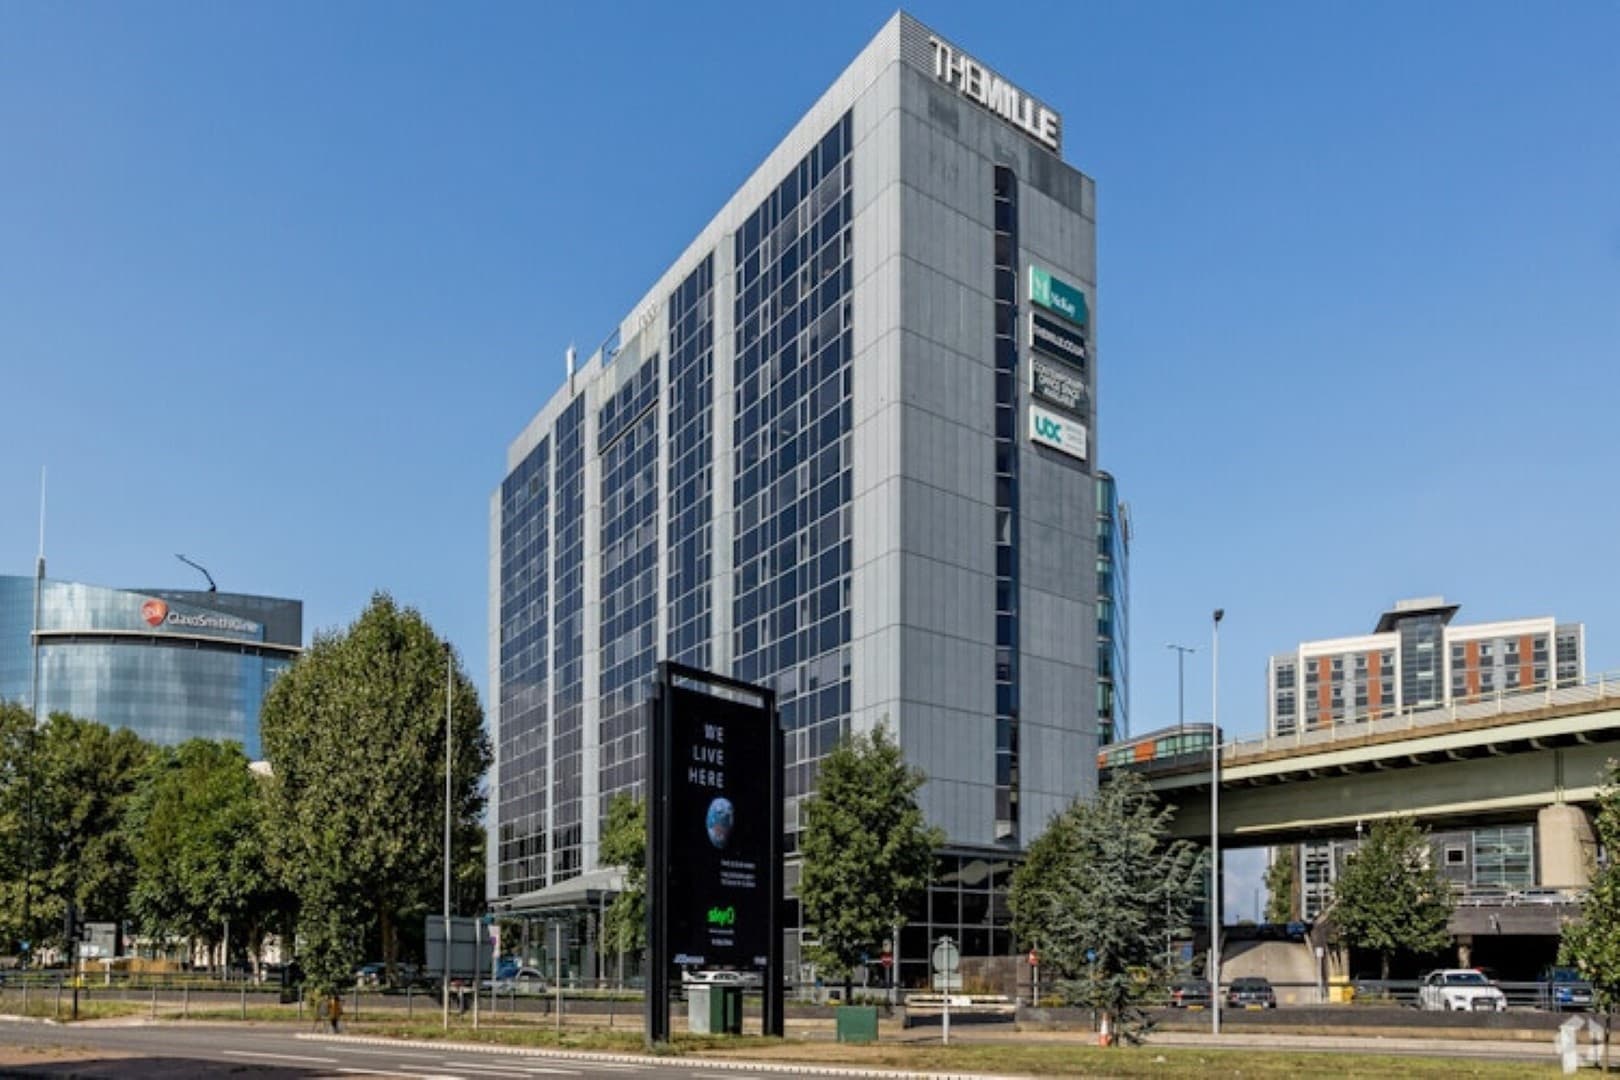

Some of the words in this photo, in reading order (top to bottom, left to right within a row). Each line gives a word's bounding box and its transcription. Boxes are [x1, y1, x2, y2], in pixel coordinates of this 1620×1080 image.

[704, 724, 723, 743] WE
[692, 745, 723, 766] LIVE
[688, 766, 723, 788] HERE
